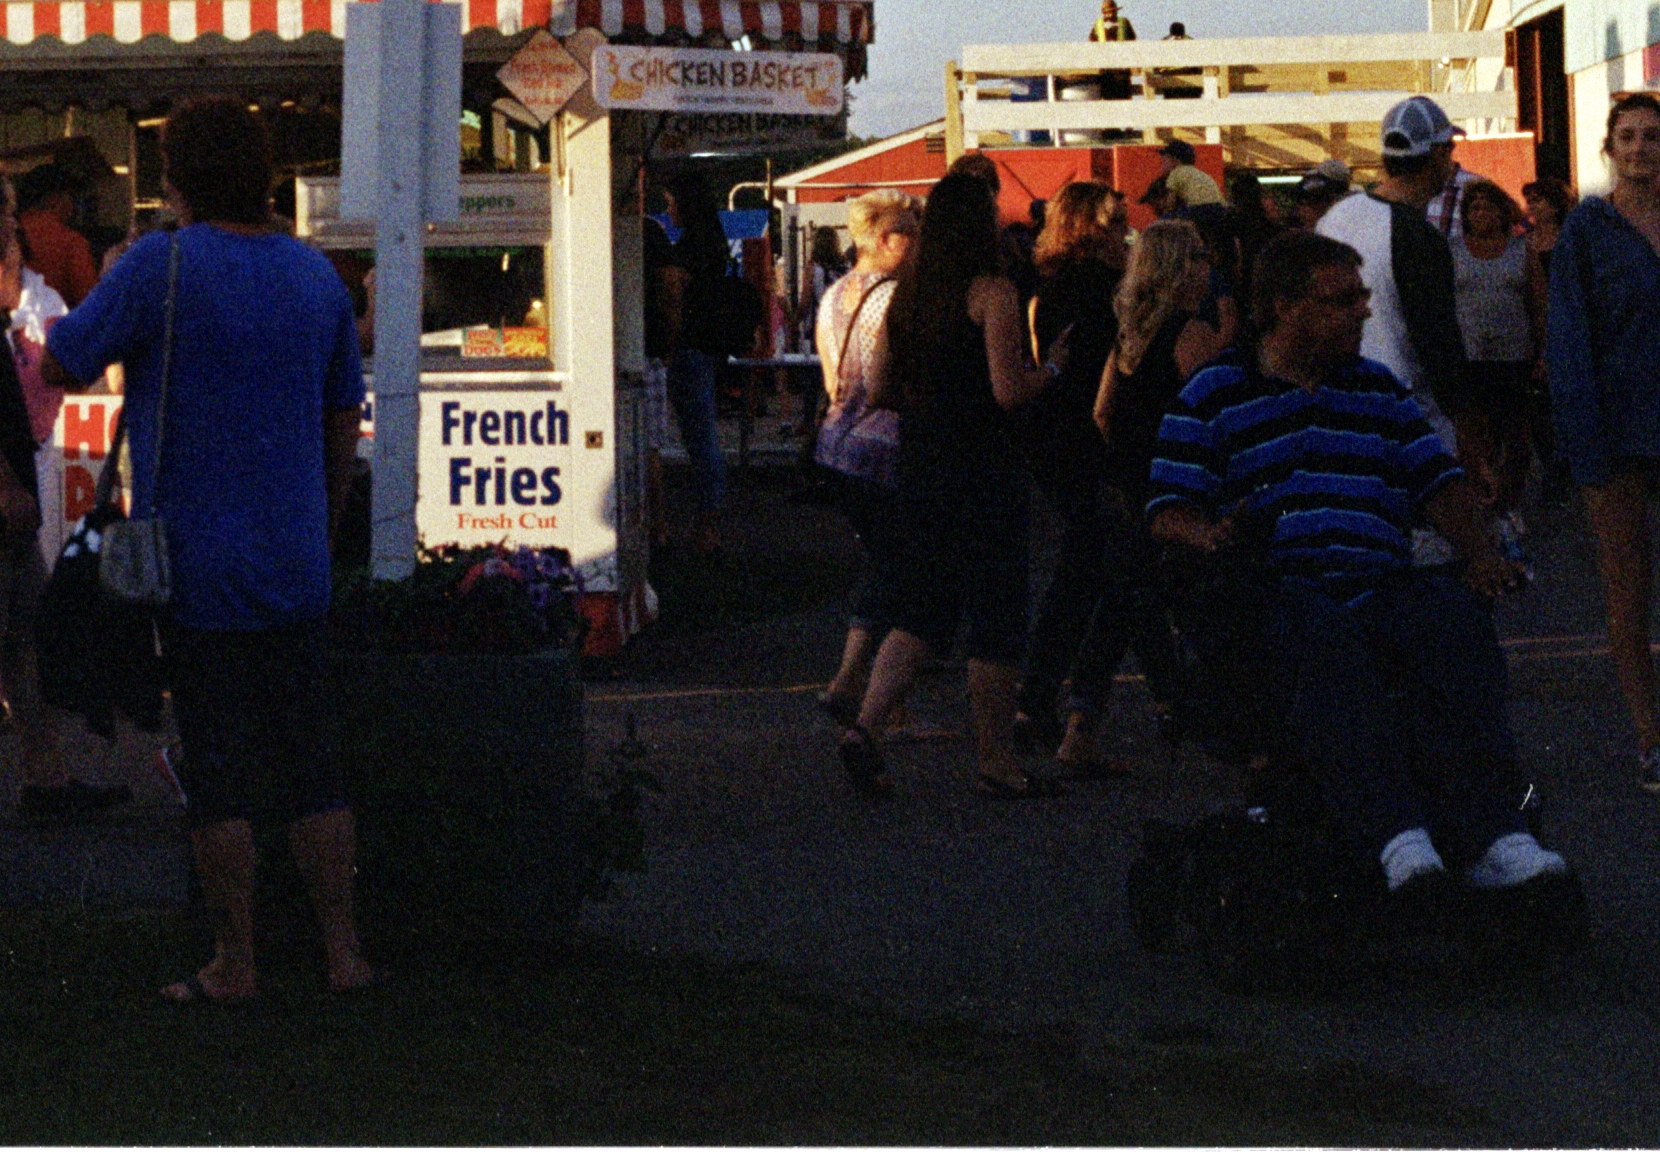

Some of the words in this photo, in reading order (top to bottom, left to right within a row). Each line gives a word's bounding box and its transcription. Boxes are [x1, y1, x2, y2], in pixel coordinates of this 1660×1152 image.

[630, 57, 727, 87] CHICKEN
[731, 59, 820, 91] BASKET
[441, 400, 570, 445] French
[449, 456, 562, 506] Fries
[457, 513, 513, 530] Fresh
[518, 513, 558, 530] Cut
